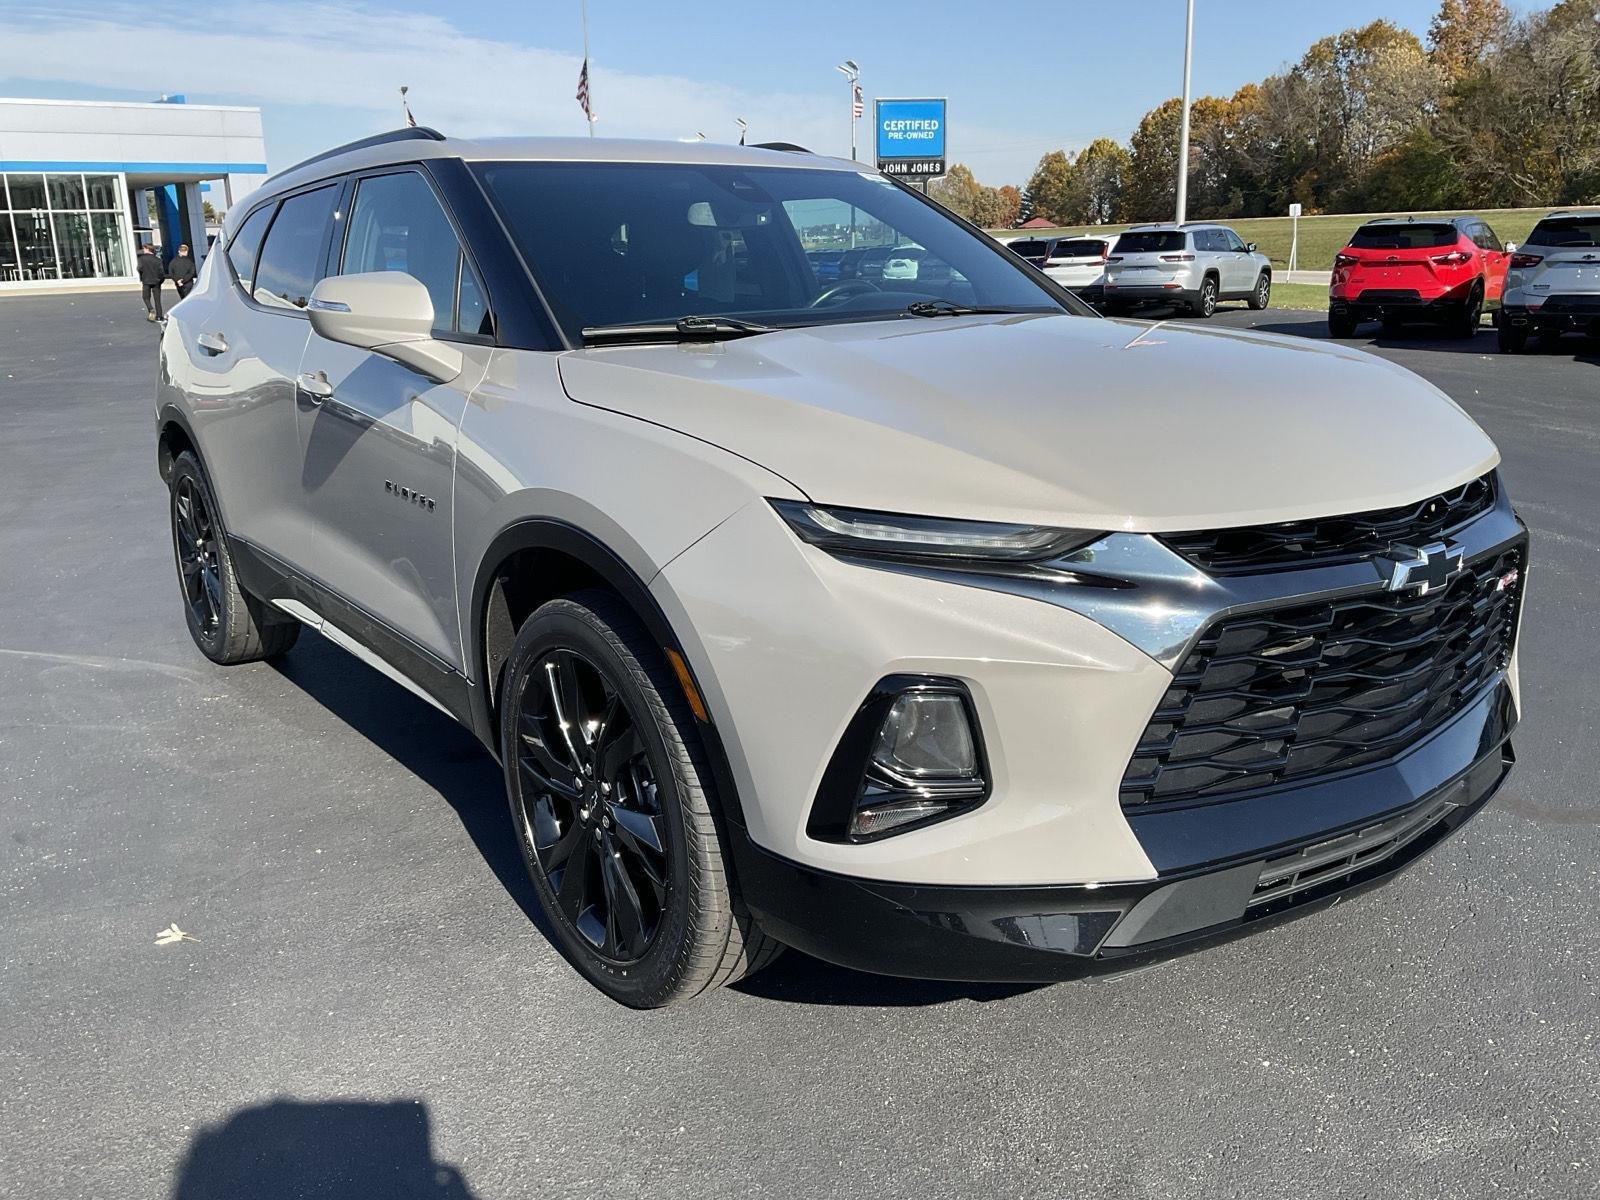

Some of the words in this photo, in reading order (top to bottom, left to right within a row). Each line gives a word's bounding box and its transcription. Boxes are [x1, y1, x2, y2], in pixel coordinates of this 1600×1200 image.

[883, 120, 939, 131] CERTIFIED
[888, 131, 935, 140] PRE-OWNED
[883, 163, 908, 173] JOHN
[911, 163, 941, 172] JONES
[385, 479, 436, 511] BLAZER
